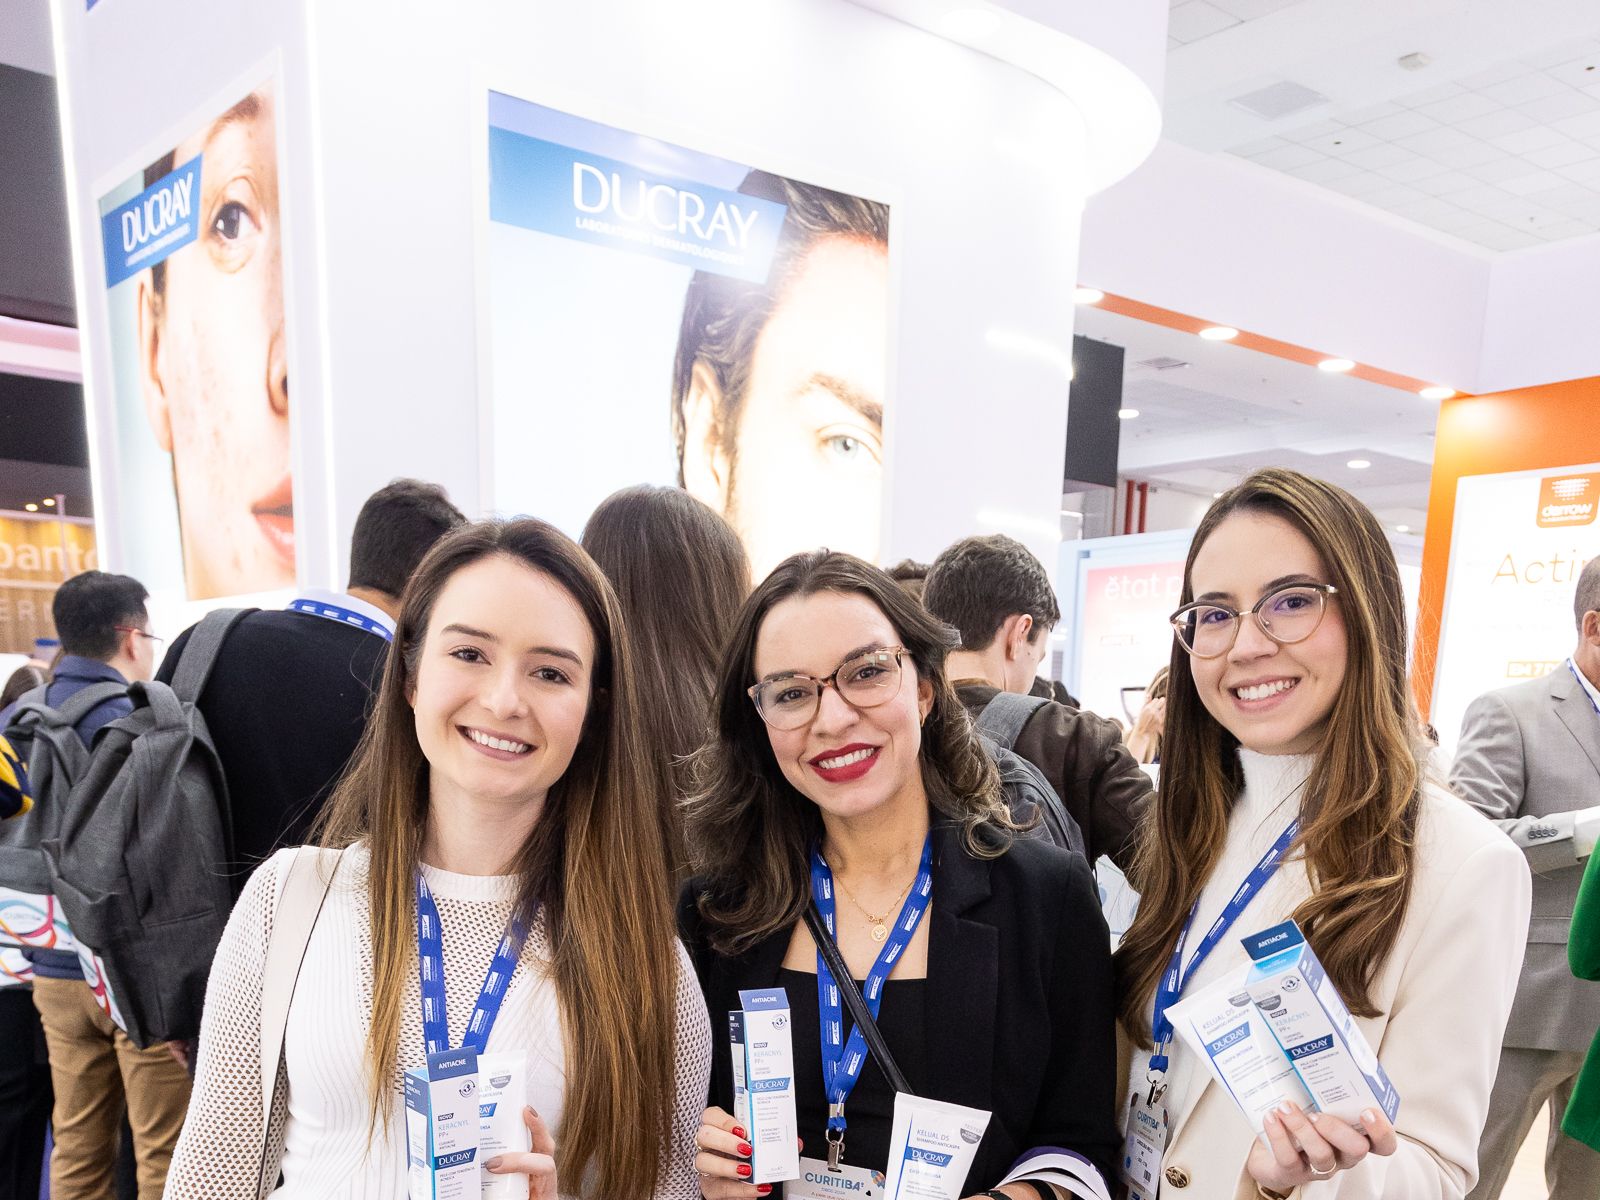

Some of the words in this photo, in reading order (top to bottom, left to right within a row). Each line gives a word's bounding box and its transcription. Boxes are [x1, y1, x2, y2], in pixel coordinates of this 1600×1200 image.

[121, 171, 193, 252] DUCRAY
[573, 161, 759, 249] DUCRAY
[1491, 549, 1587, 585] Acti
[1257, 932, 1288, 948] ANTIACNE
[751, 996, 777, 1004] ANTIACNE
[1271, 1009, 1286, 1018] NOVO
[1212, 1027, 1245, 1052] DUCRAY
[1291, 1038, 1328, 1056] DUCRAY
[438, 1058, 467, 1070] ANTIACNE
[755, 1080, 785, 1089] DUCRAY
[439, 1113, 453, 1121] NOVO
[917, 1128, 939, 1140] KELUAL
[438, 1152, 471, 1165] DUCRAY
[912, 1149, 946, 1163] DUCRAY
[805, 1172, 862, 1191] CURITIBA
